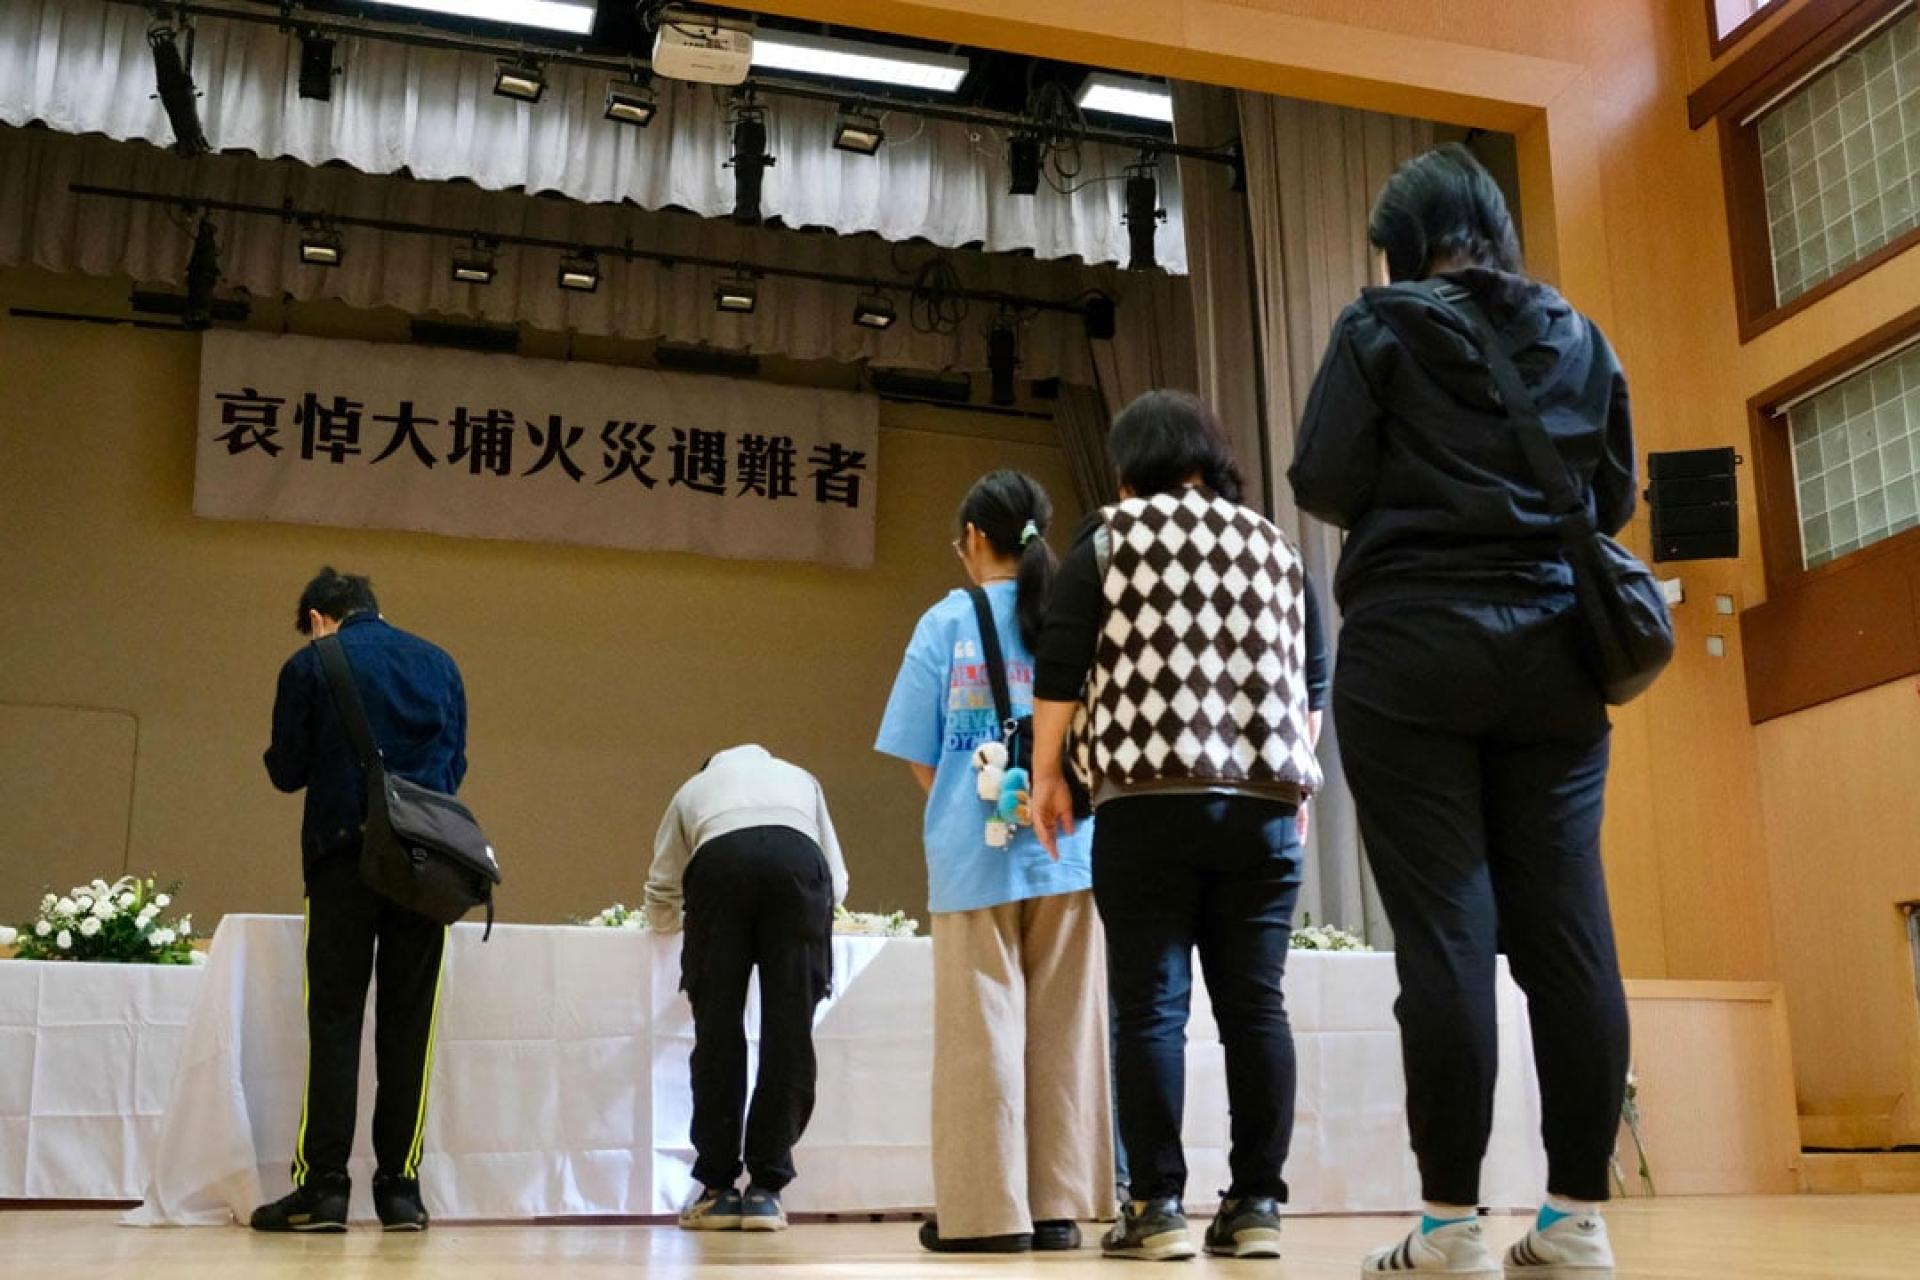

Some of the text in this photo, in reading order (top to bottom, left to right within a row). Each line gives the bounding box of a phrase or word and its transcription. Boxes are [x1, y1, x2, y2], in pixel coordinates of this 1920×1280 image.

[214, 388, 868, 508] 哀悼大埔火災遇難者
